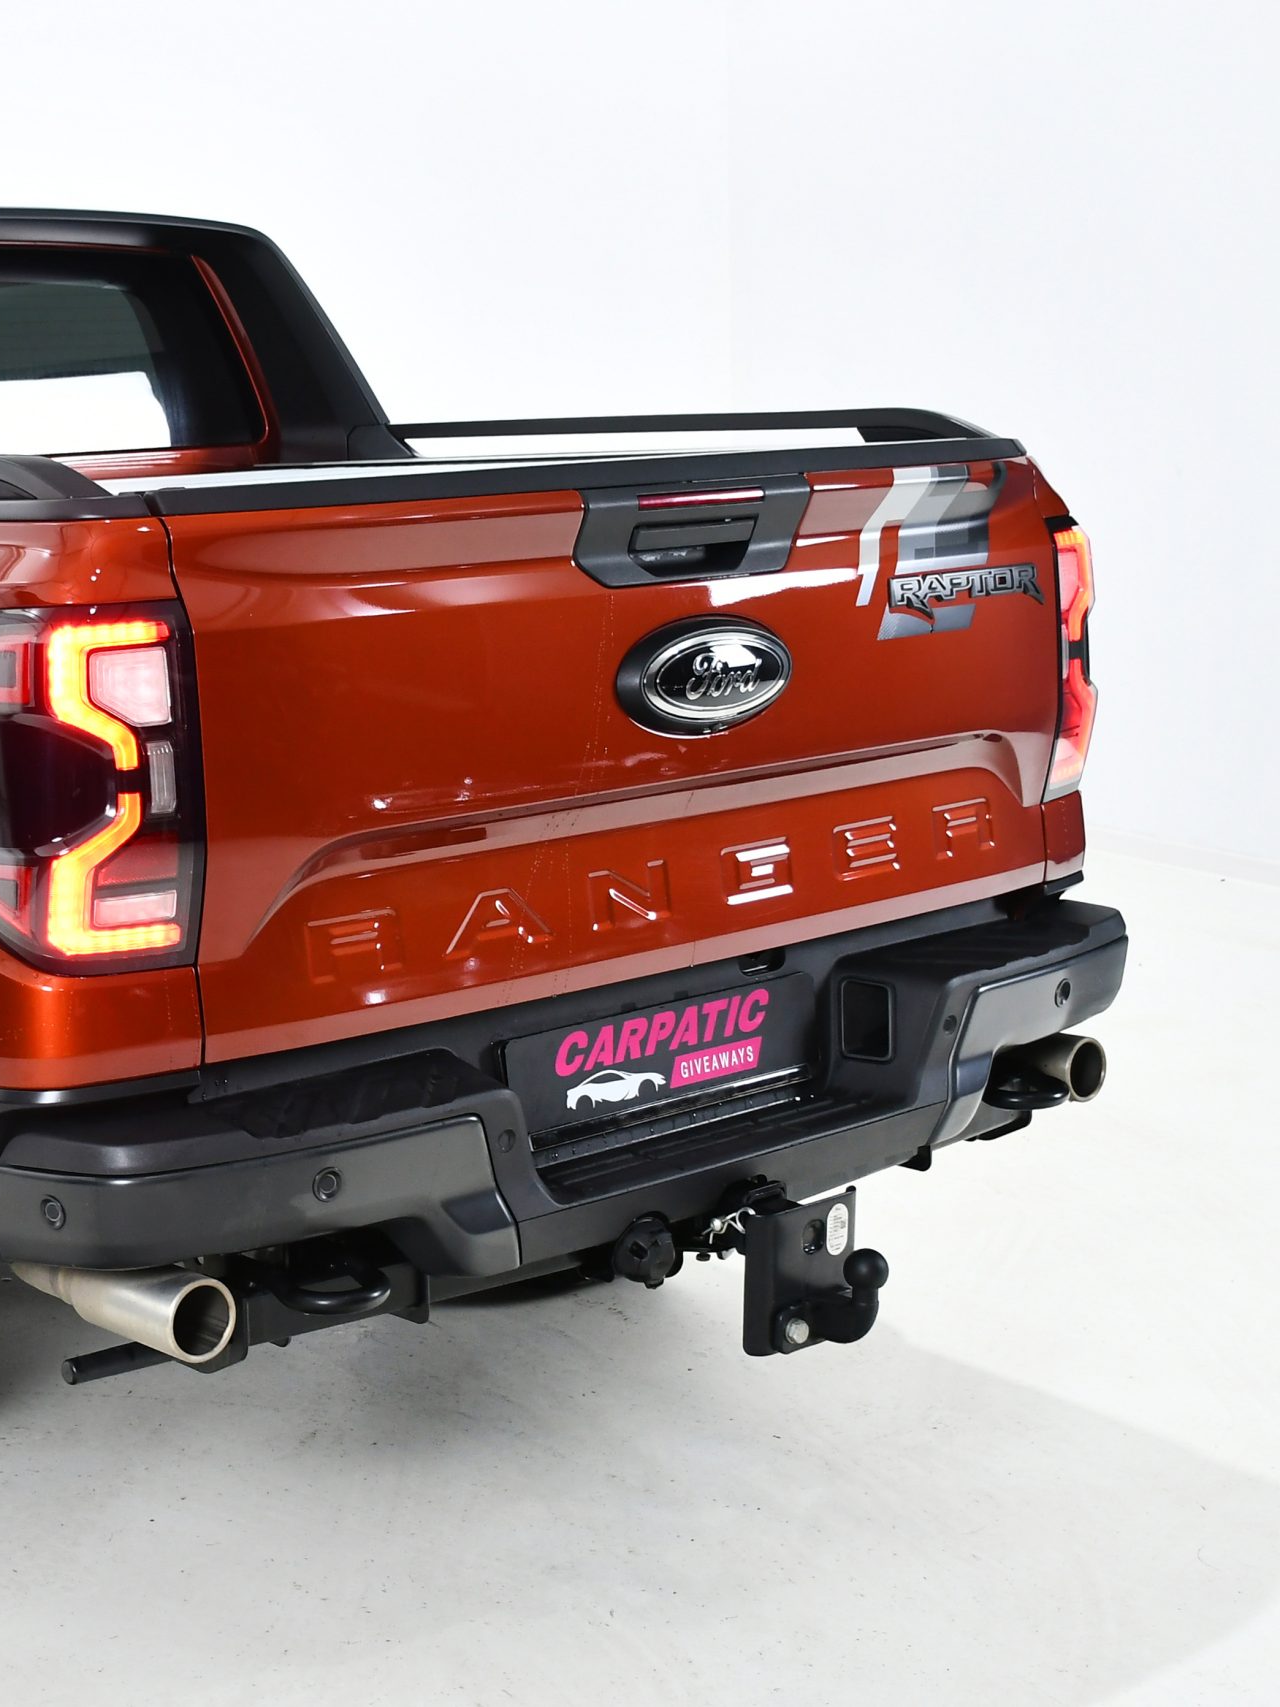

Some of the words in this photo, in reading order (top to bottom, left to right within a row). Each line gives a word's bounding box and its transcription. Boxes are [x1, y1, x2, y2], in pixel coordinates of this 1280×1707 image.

[888, 563, 1044, 619] RAPTOR
[685, 651, 763, 701] Ford
[308, 797, 996, 984] RANGER
[555, 988, 769, 1077] CARPATIC
[680, 1045, 755, 1079] GIVEAWAYS
